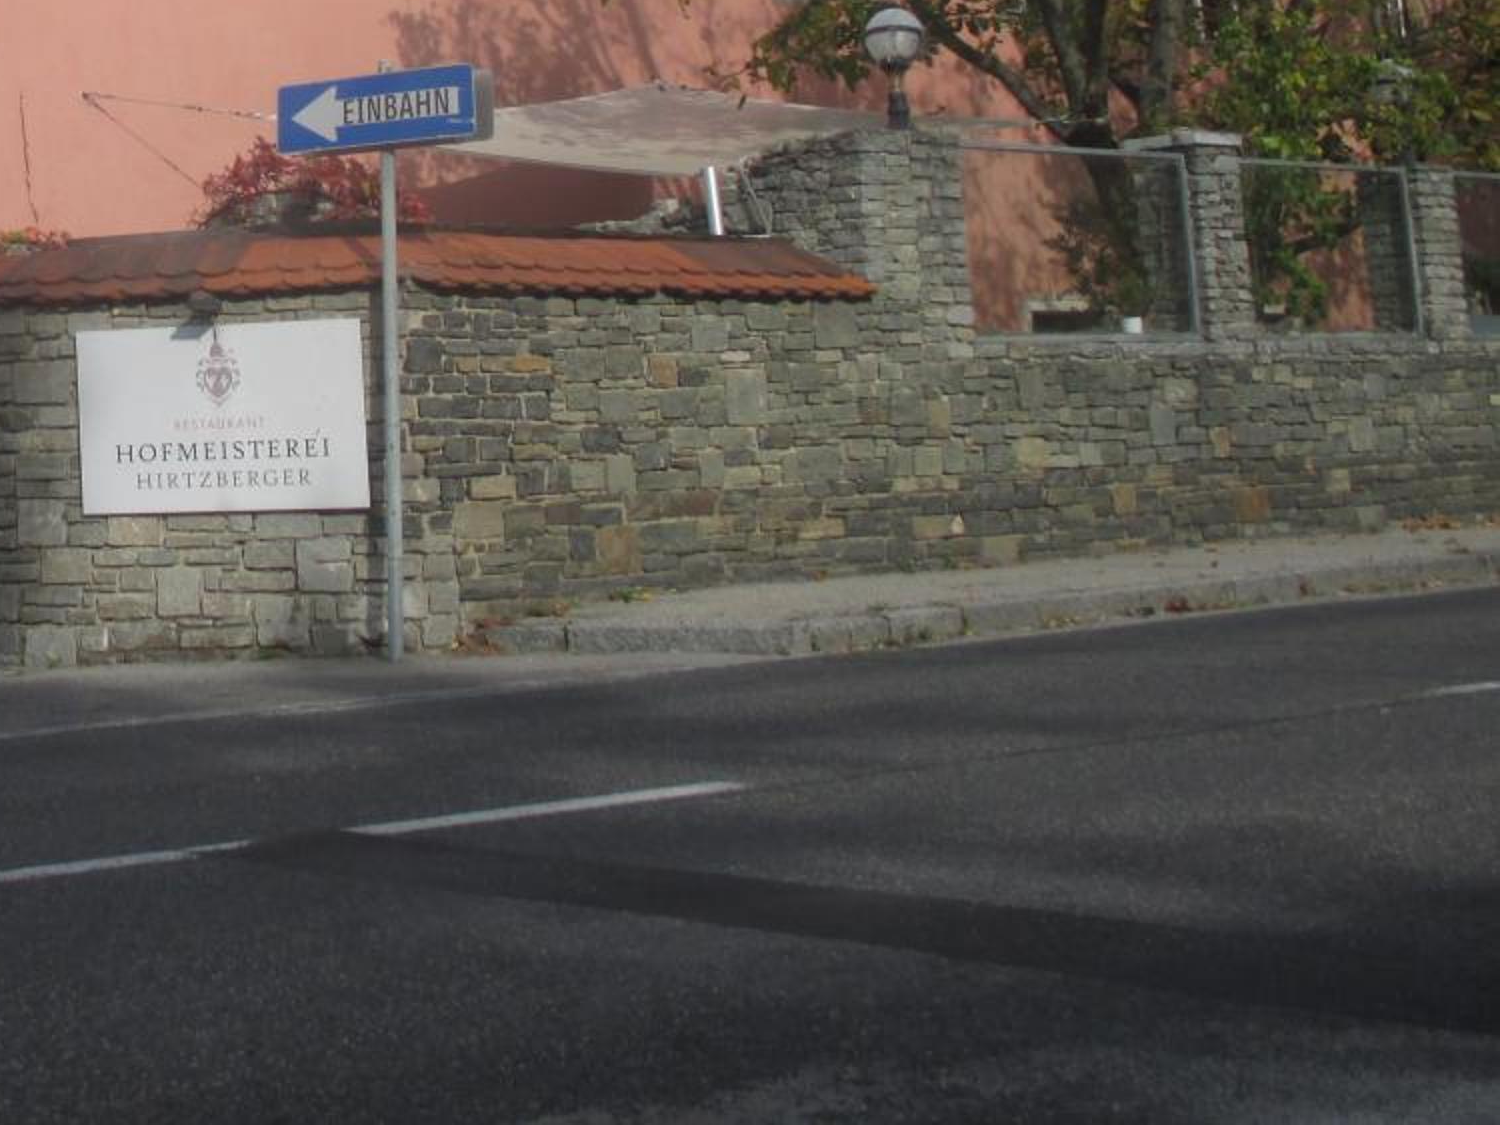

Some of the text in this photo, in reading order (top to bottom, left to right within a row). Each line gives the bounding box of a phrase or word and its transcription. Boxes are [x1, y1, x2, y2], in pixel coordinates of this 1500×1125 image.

[343, 88, 450, 124] EINBAHN
[115, 437, 330, 464] HOFMEISTEREI
[136, 469, 312, 491] HIRTZBERGER
